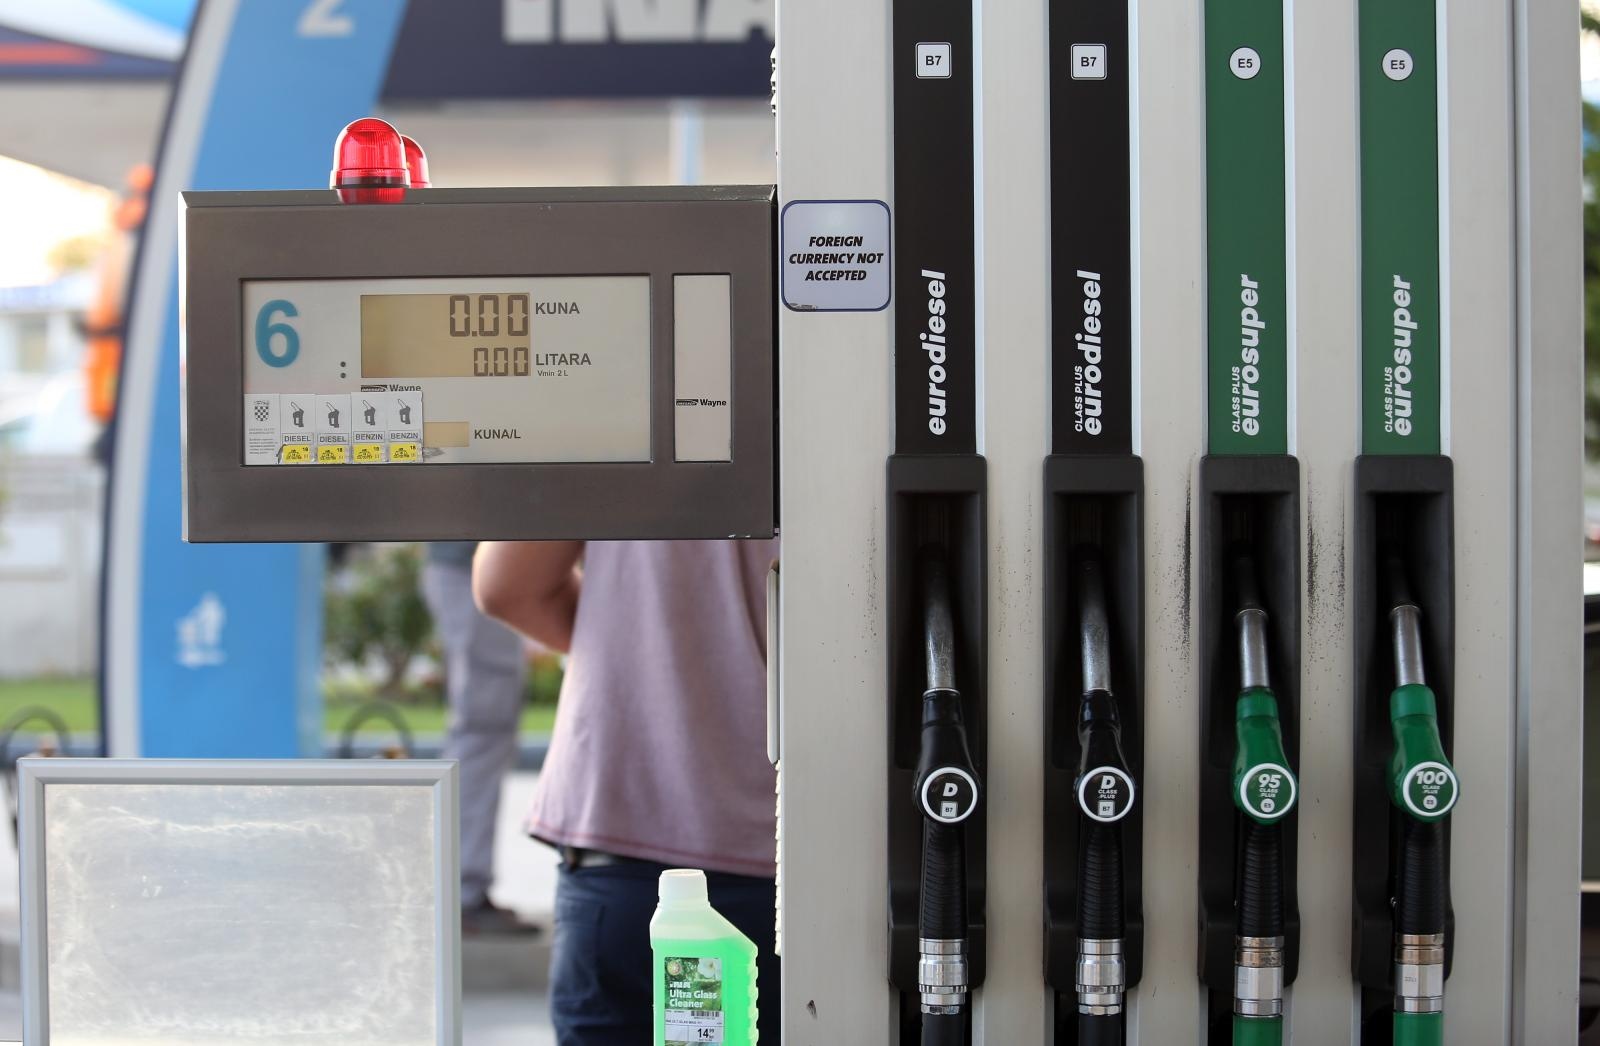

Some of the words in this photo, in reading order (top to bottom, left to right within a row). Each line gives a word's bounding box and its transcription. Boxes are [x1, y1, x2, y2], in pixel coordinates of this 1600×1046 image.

[925, 55, 942, 66] B7
[1080, 56, 1097, 67] B7
[1237, 58, 1253, 69] E5
[1389, 60, 1406, 70] E5
[809, 236, 864, 247] FOREIGN
[789, 253, 855, 264] CURRENCY
[857, 253, 884, 264] NOT
[804, 270, 867, 281] ACCEPTED
[535, 302, 580, 315] KUNA
[450, 294, 529, 337] 0.00
[255, 299, 300, 368] 6
[919, 269, 947, 436] eurodiesel
[1075, 270, 1102, 436] eurodiesel
[1241, 274, 1266, 436] eurosuper
[1393, 274, 1418, 436] eurosuper
[473, 347, 529, 377] 0.00
[535, 353, 592, 366] LITARA
[537, 369, 555, 377] Vmin
[1074, 365, 1083, 394] PLUS
[1232, 366, 1240, 394] PLUS
[1384, 366, 1393, 395] PLUS
[700, 398, 727, 408] Wayne
[1074, 395, 1083, 432] CLASS
[1232, 396, 1240, 433] CLASS
[1384, 396, 1393, 433] CLASS
[284, 435, 312, 443] DIESEL
[319, 435, 347, 443] DIESEL
[355, 433, 384, 441] BENZIN
[390, 432, 419, 440] BENZIN
[474, 429, 521, 440] KUNA/L
[1101, 775, 1116, 789] D
[1259, 773, 1281, 788] 95
[1416, 771, 1448, 785] 100
[943, 783, 958, 797] D
[669, 989, 692, 998] Ultra
[693, 990, 717, 999] Glass
[669, 998, 704, 1008] Cleaner
[697, 1028, 709, 1038] 14
